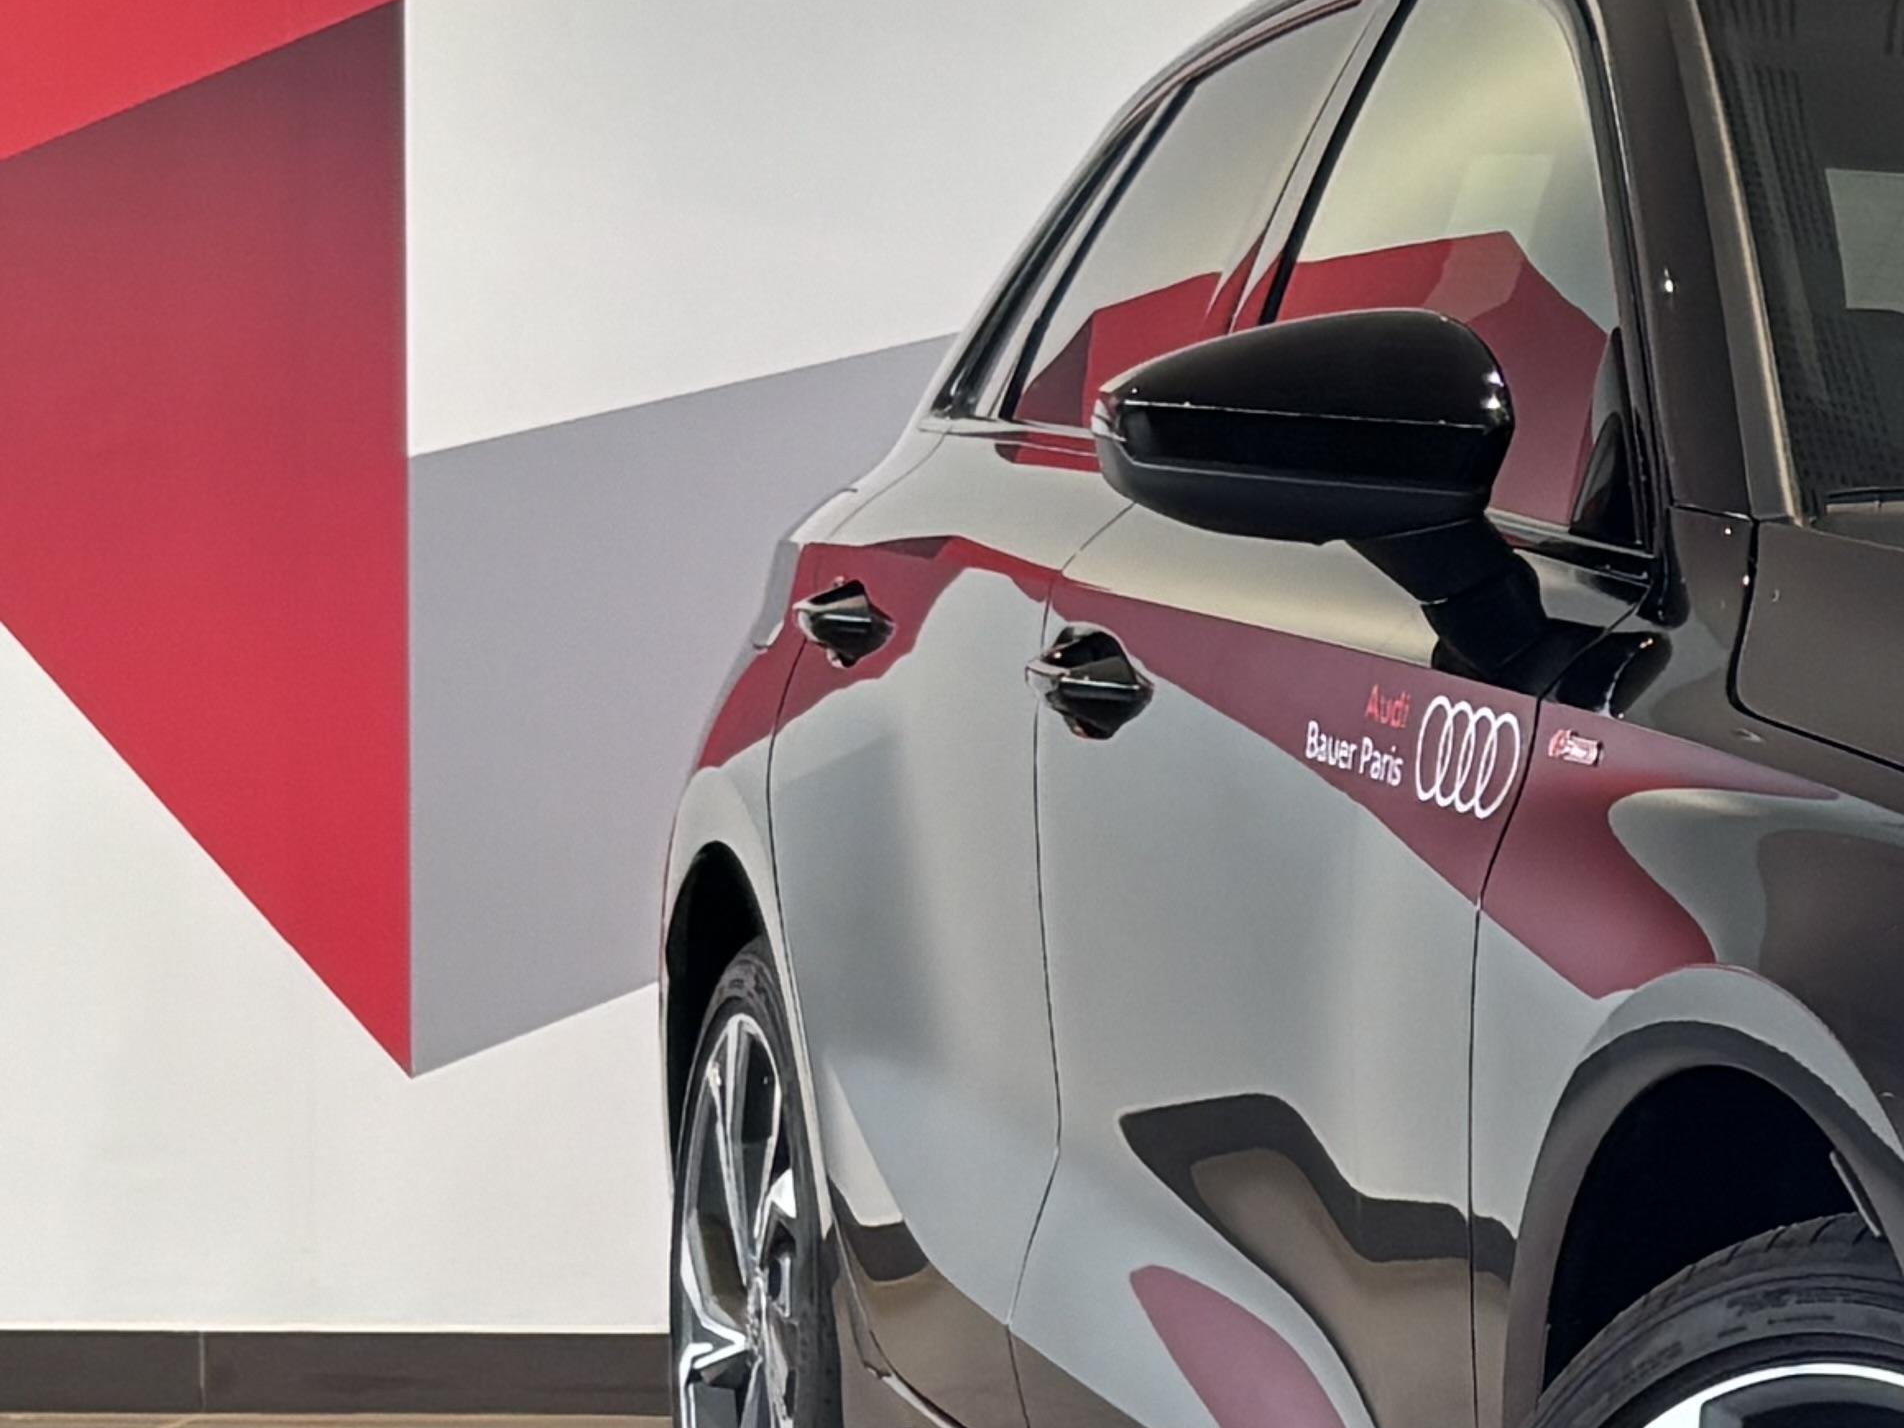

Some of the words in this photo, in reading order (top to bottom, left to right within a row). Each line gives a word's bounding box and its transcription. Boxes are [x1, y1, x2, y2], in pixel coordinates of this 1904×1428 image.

[1365, 684, 1410, 728] Audi
[1305, 720, 1357, 769] Bauer
[1359, 737, 1404, 787] Paris
